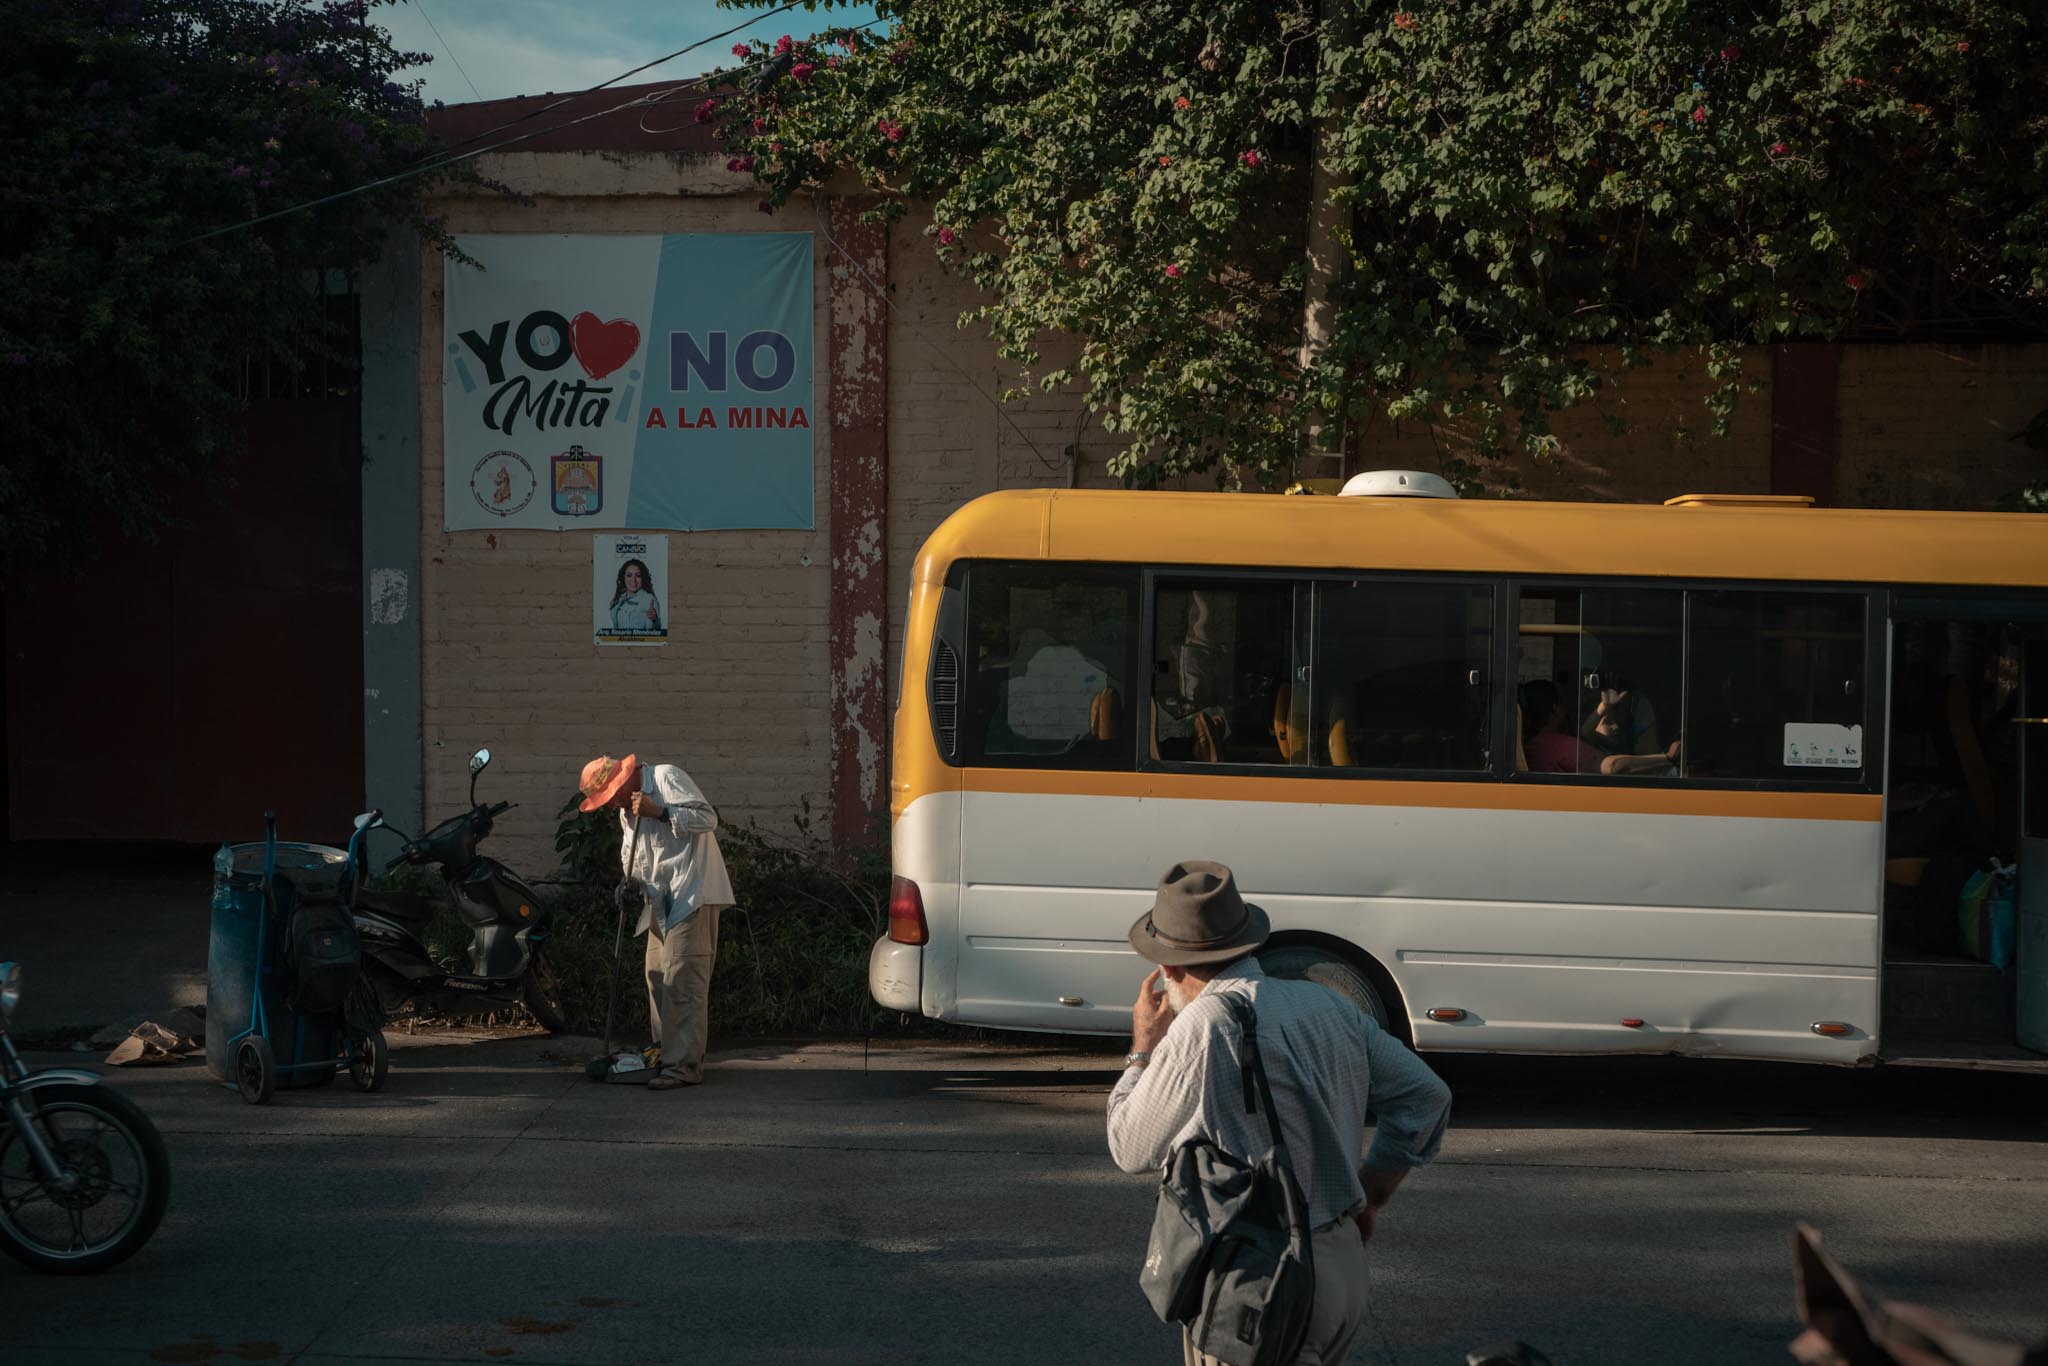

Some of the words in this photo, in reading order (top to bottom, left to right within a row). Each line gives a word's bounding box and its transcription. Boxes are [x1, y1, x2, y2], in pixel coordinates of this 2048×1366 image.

[669, 329, 796, 393] NO
[645, 407, 667, 429] A
[678, 407, 717, 429] LA
[727, 407, 810, 429] MINA
